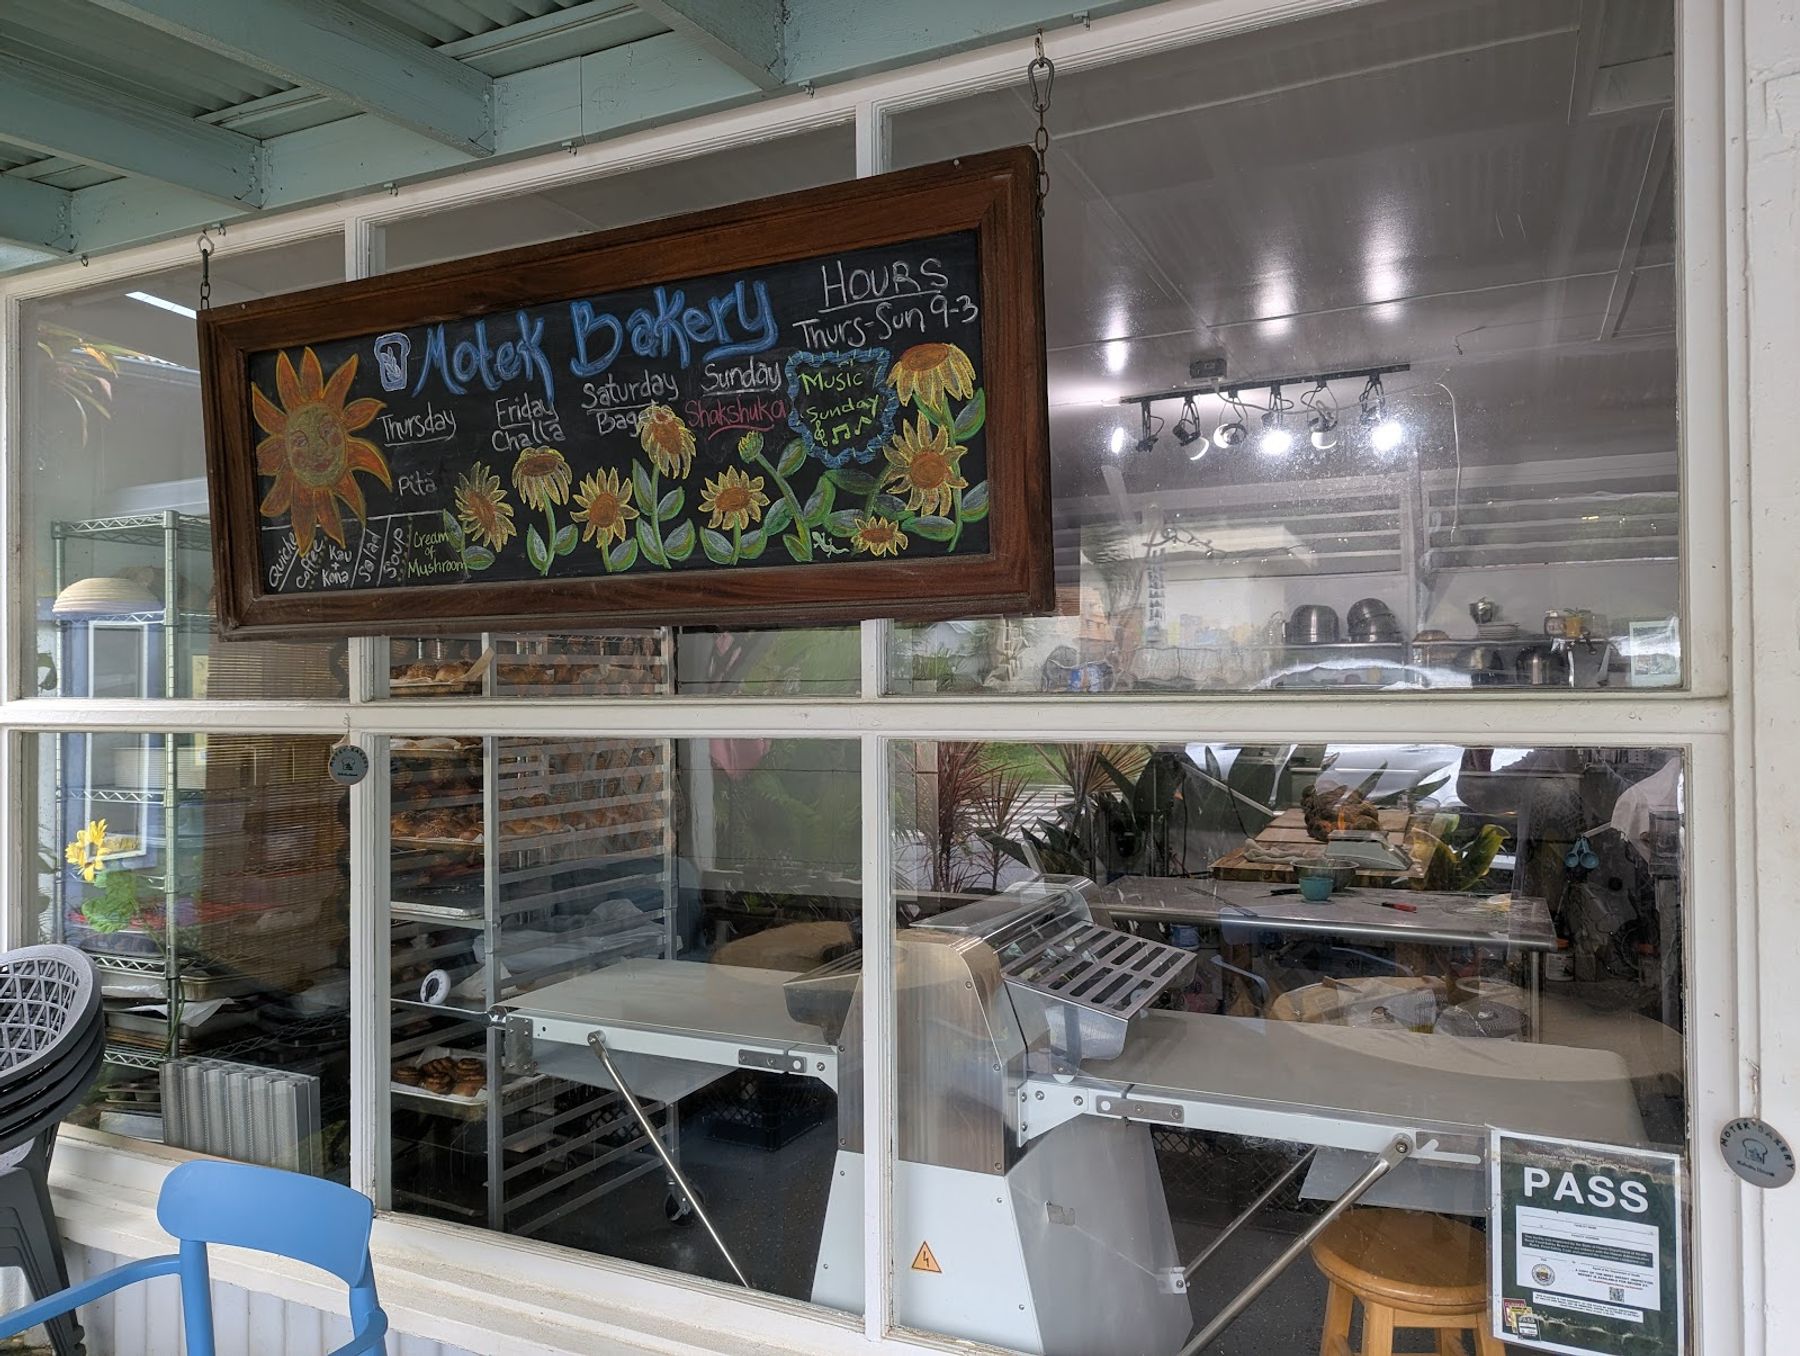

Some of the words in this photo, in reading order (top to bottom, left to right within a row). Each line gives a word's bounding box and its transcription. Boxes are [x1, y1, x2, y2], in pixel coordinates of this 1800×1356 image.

[930, 294, 979, 328] 9-3
[581, 369, 679, 409] Saturday
[701, 356, 782, 391] Sunday
[376, 401, 457, 441] Thursday
[495, 392, 560, 426] Friday
[685, 396, 789, 428] Shakshuka
[806, 394, 880, 423] Sunday
[491, 419, 566, 451] Challa
[328, 544, 352, 563] Kau
[413, 531, 449, 548] Cream
[424, 544, 437, 559] of
[321, 567, 350, 588] Kona
[407, 557, 467, 578] Mushroom
[1720, 1121, 1751, 1147] MOTEK
[1523, 1166, 1649, 1213] PASS
